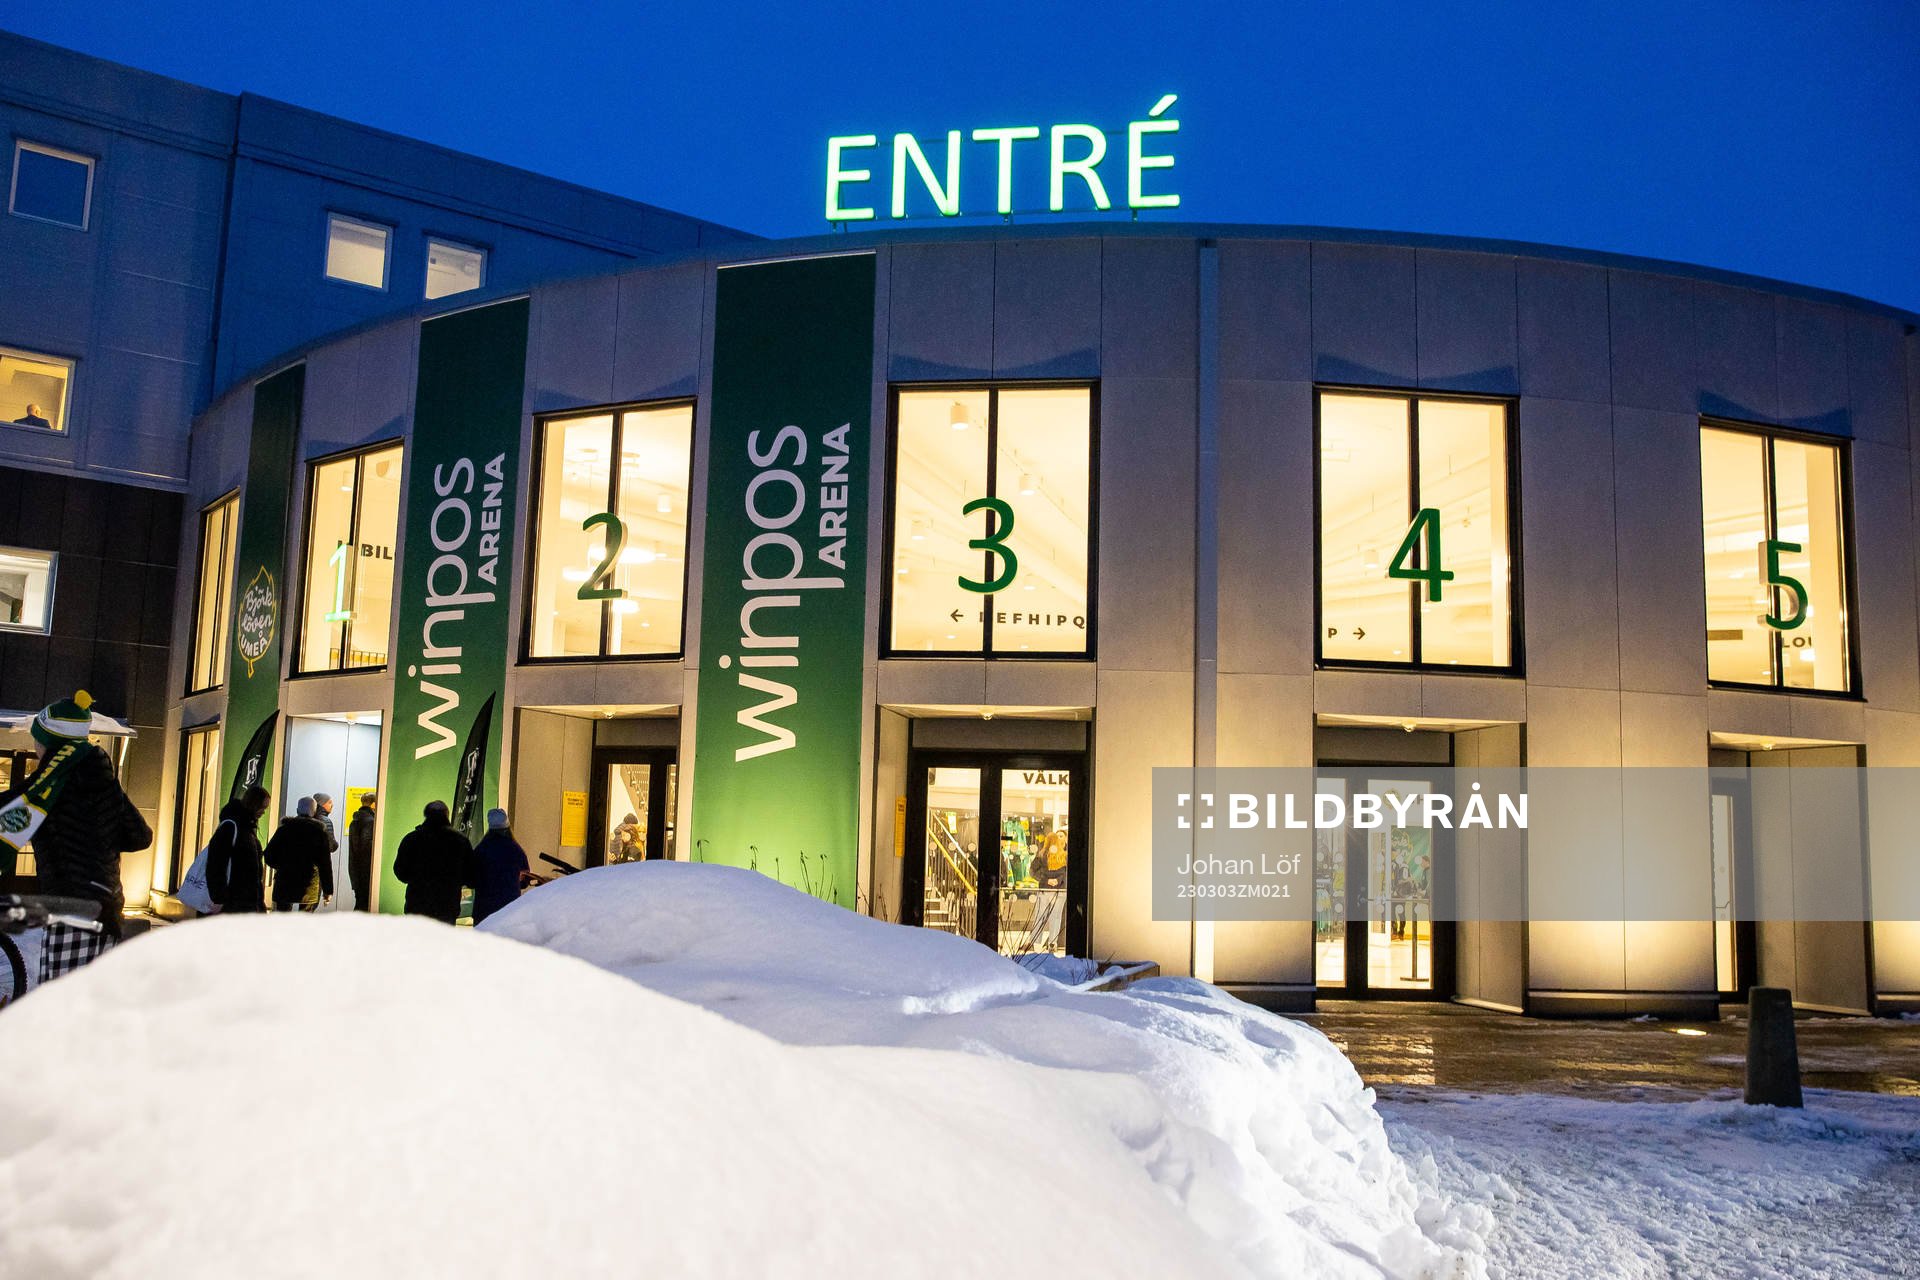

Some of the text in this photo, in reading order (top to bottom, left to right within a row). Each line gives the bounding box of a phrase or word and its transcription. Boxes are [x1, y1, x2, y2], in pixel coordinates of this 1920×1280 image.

[825, 94, 1181, 221] ENTRÉ
[478, 453, 506, 585] ARENA
[819, 423, 851, 570] ARENA
[958, 496, 1018, 594] 3
[324, 543, 352, 623] 1
[577, 512, 627, 600] 2
[719, 425, 845, 762] winpos
[1388, 508, 1455, 602] 4
[1765, 540, 1809, 630] 5
[408, 457, 496, 760] winpos
[1327, 627, 1338, 639] P
